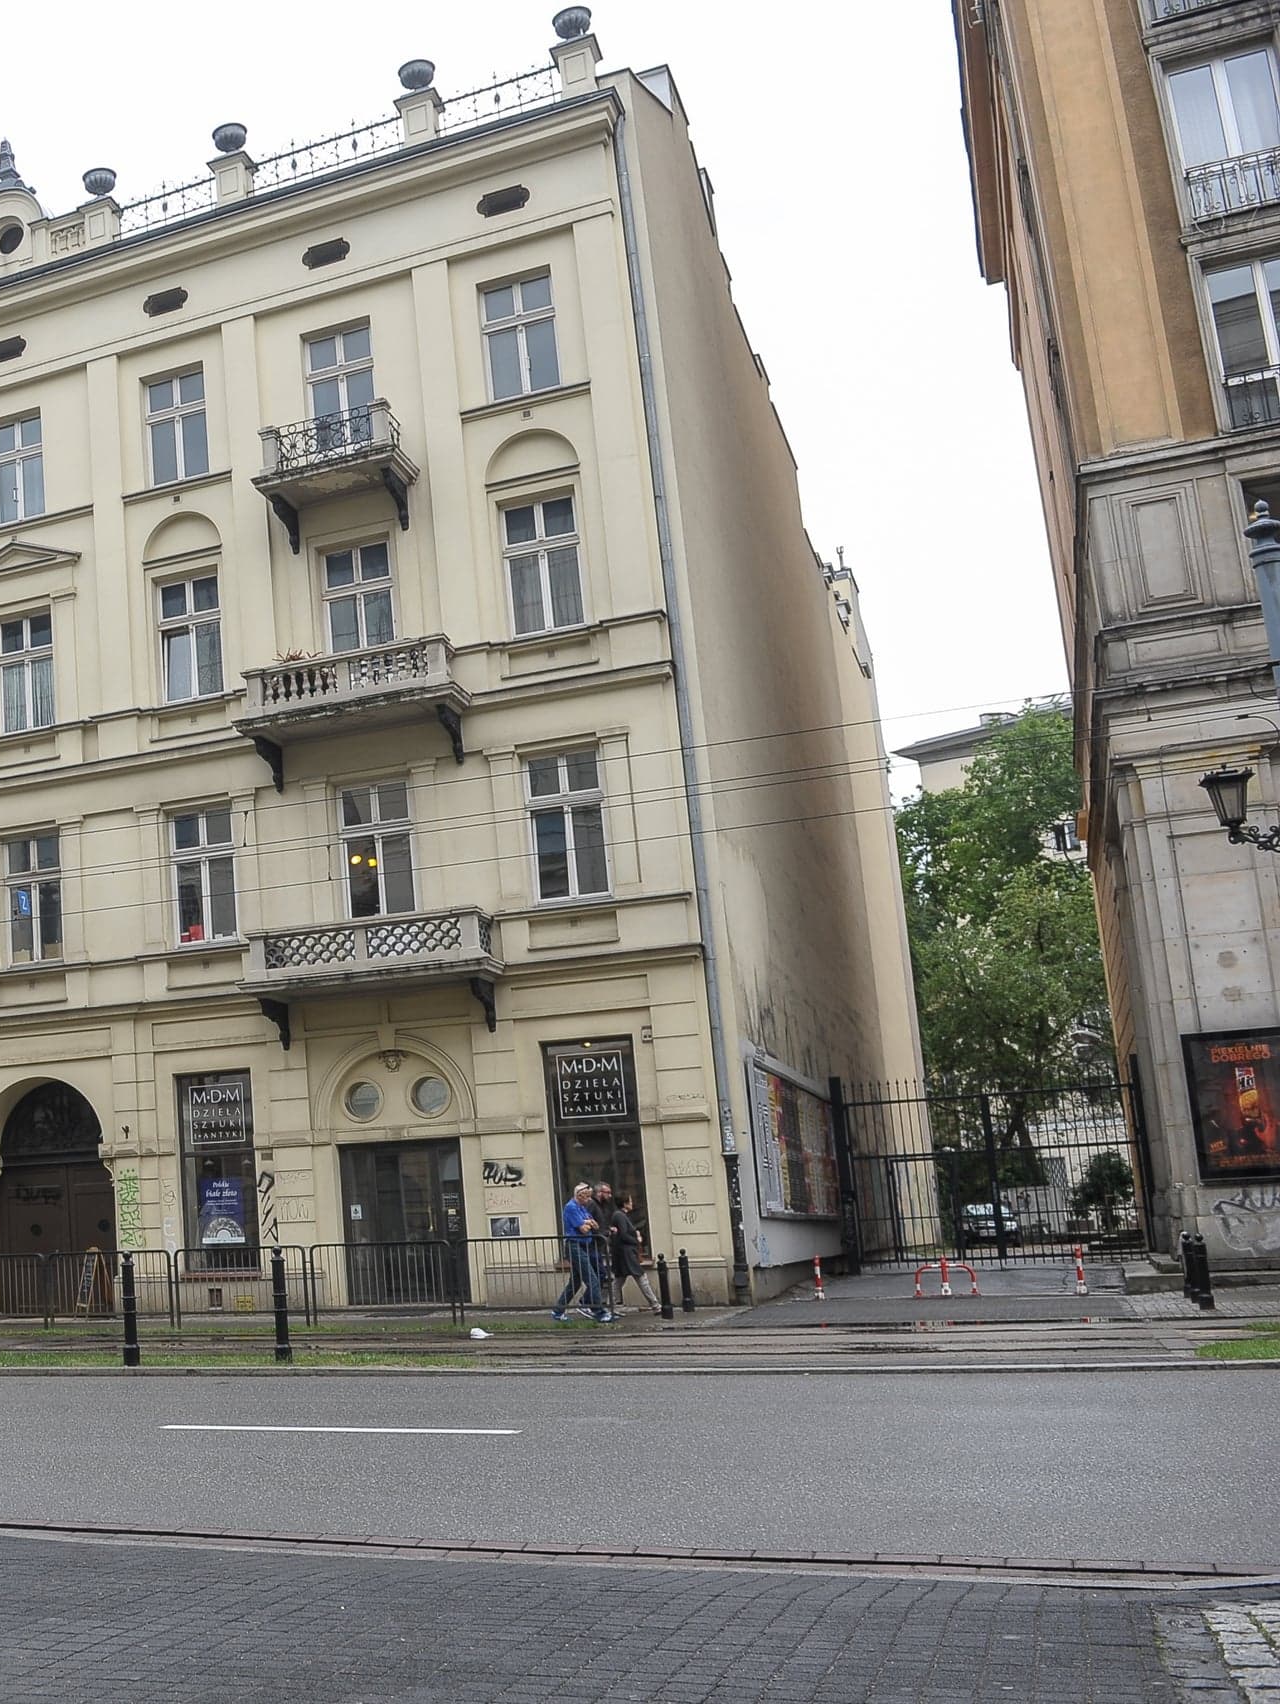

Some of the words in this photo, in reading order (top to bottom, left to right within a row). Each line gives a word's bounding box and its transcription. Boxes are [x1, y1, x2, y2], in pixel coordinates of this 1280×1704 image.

[1211, 1052, 1271, 1063] DOBREGO
[563, 1090, 621, 1102] SZTUKI
[193, 1119, 241, 1130] SZTUKI
